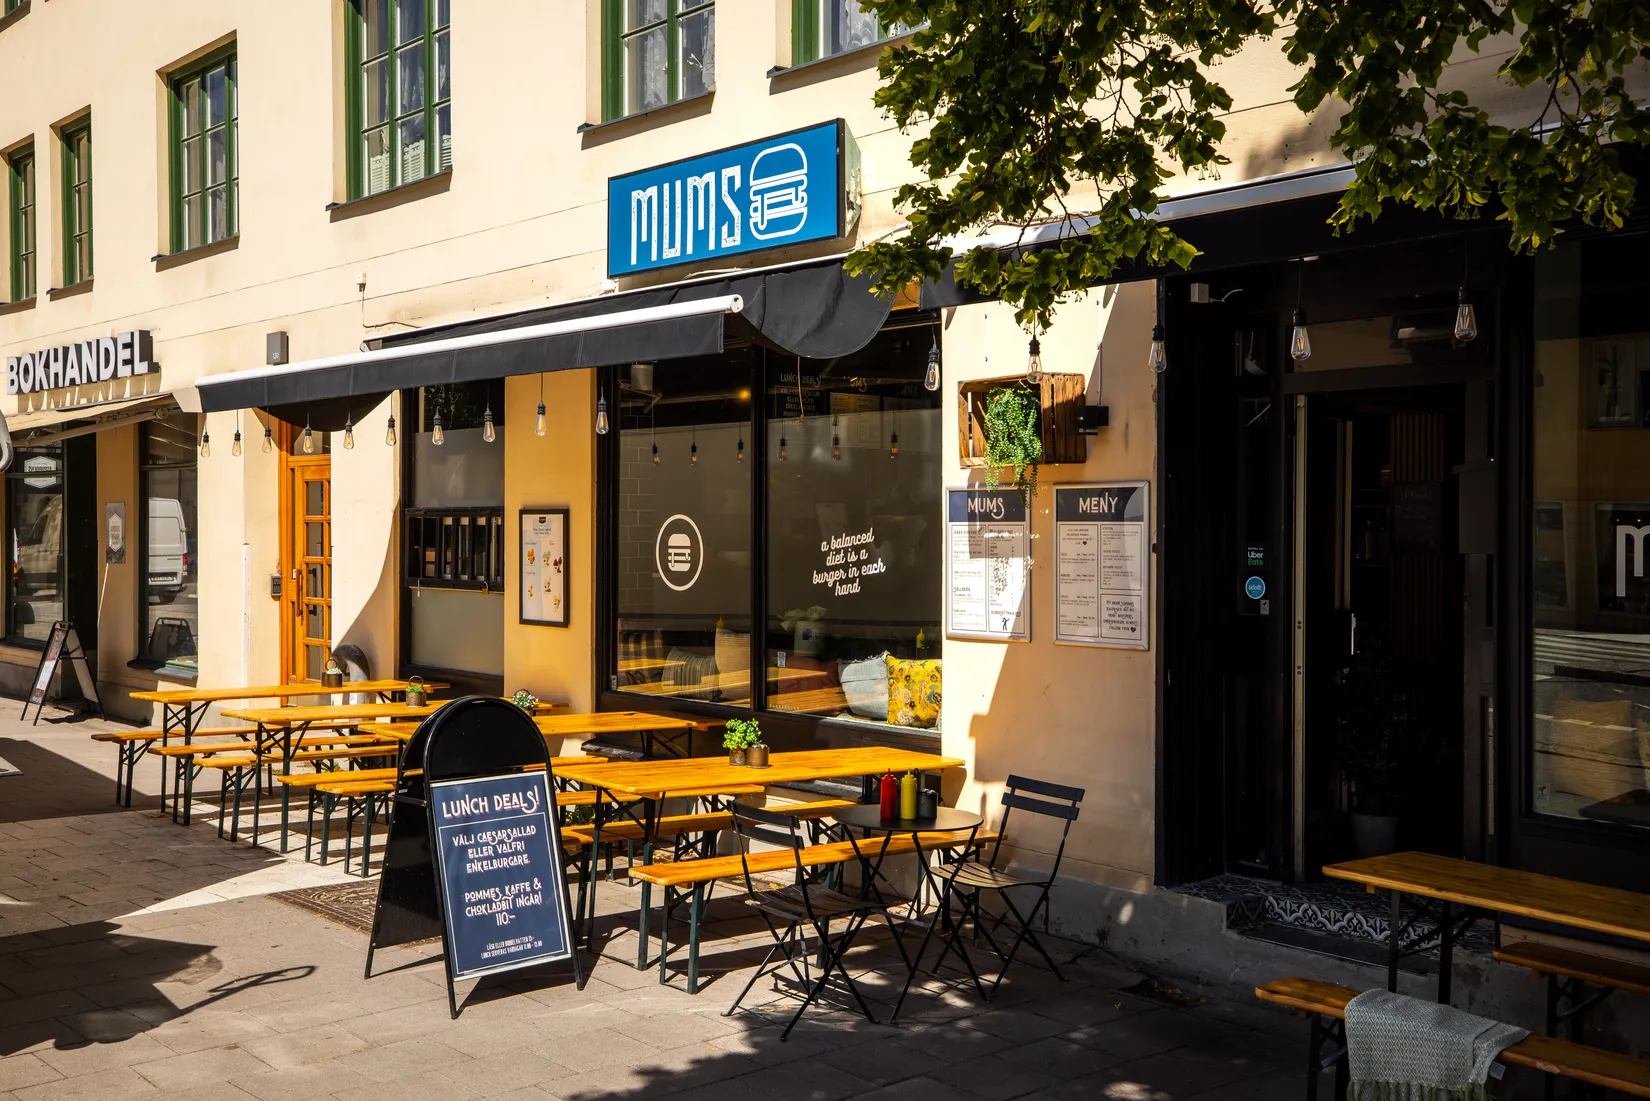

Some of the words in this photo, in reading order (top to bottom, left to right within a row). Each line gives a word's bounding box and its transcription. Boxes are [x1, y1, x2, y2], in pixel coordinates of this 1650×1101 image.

[630, 164, 742, 266] MUMS
[6, 330, 150, 395] BOKHANDEL
[967, 497, 1005, 520] MUMS
[1079, 492, 1118, 513] MENY
[821, 541, 829, 552] a
[830, 527, 875, 550] balanced
[826, 549, 846, 566] diet
[847, 548, 858, 562] is
[860, 548, 868, 560] a
[1247, 558, 1264, 566] Eats
[812, 570, 847, 587] burger
[848, 563, 860, 578] in
[861, 557, 886, 576] each
[835, 578, 861, 596] hand
[441, 794, 489, 819] LUNCH
[493, 785, 541, 814] DEALS!
[452, 833, 475, 847] VÄLJ
[477, 825, 537, 845] CAESARSALLAD
[468, 846, 494, 859] ELLER
[496, 840, 526, 854] VALFRI
[505, 881, 531, 896] KAFFE
[533, 877, 542, 889] &
[465, 895, 514, 917] CHOKLADBIT
